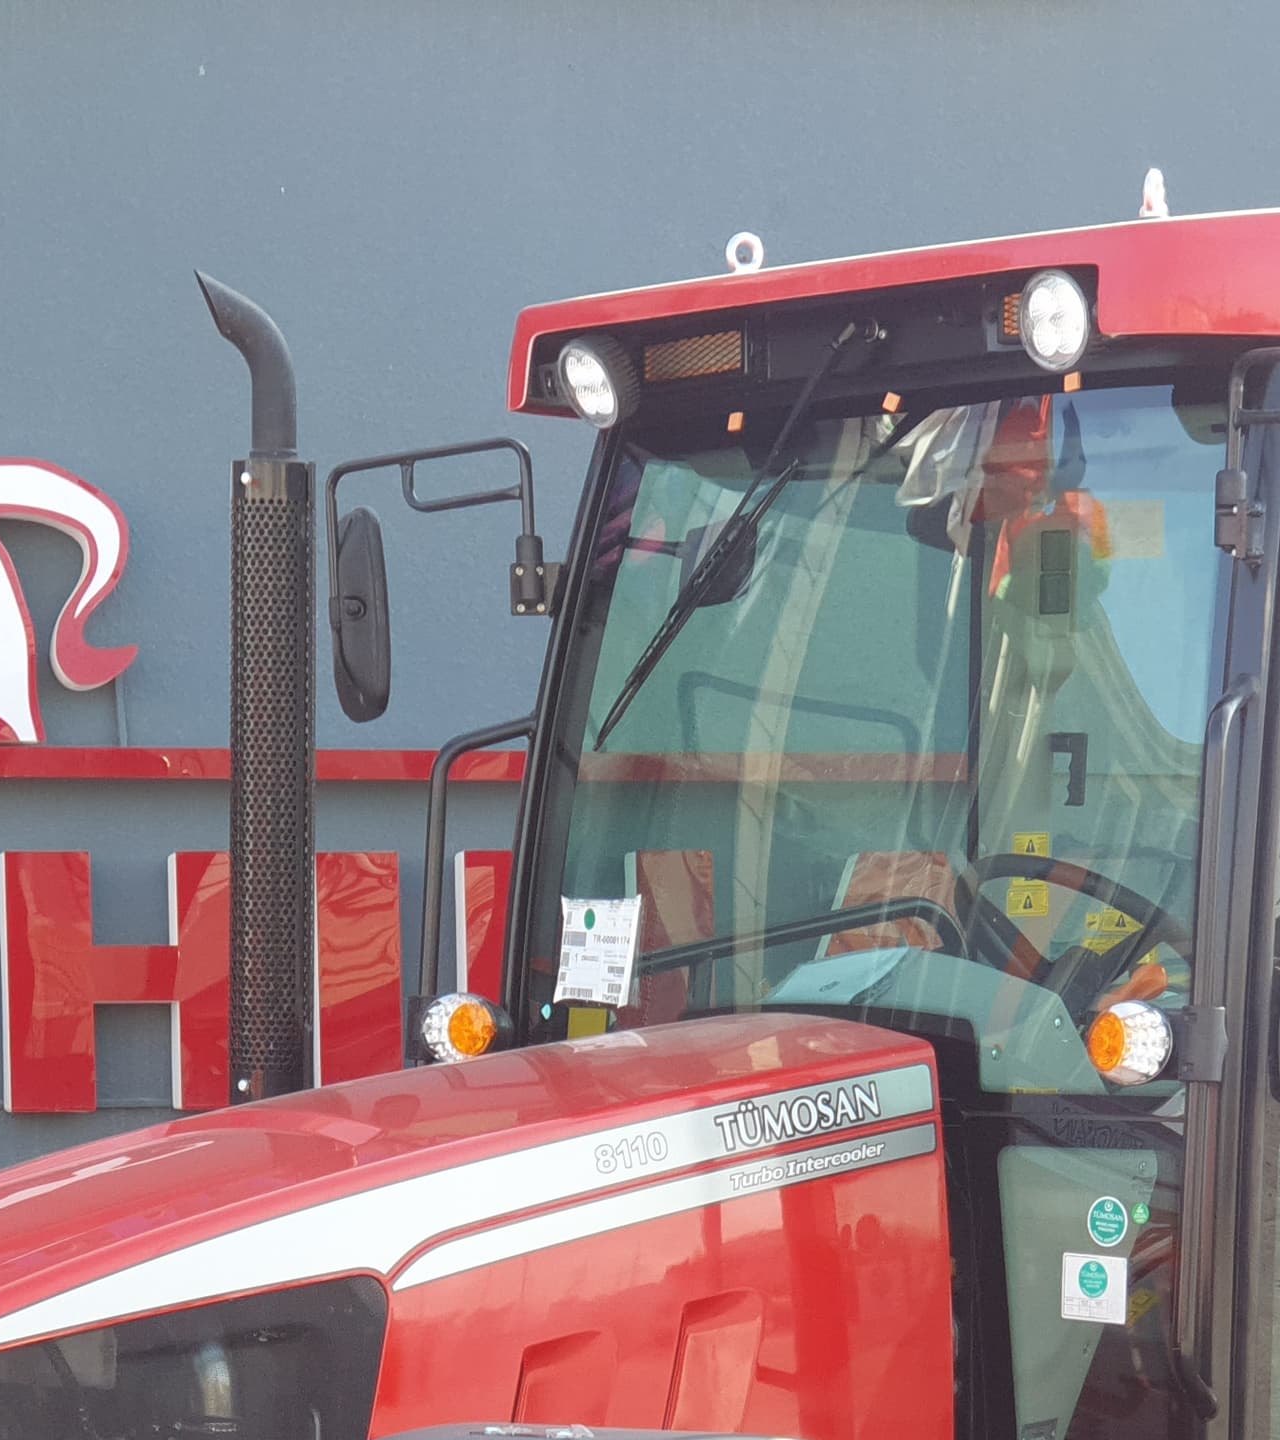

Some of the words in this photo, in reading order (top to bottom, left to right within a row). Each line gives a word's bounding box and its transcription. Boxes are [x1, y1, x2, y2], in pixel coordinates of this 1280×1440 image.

[594, 1132, 668, 1174] 8110
[715, 1081, 881, 1151] TÜMOSAN
[730, 1163, 783, 1191] Turbo
[785, 1142, 885, 1181] Intercooler
